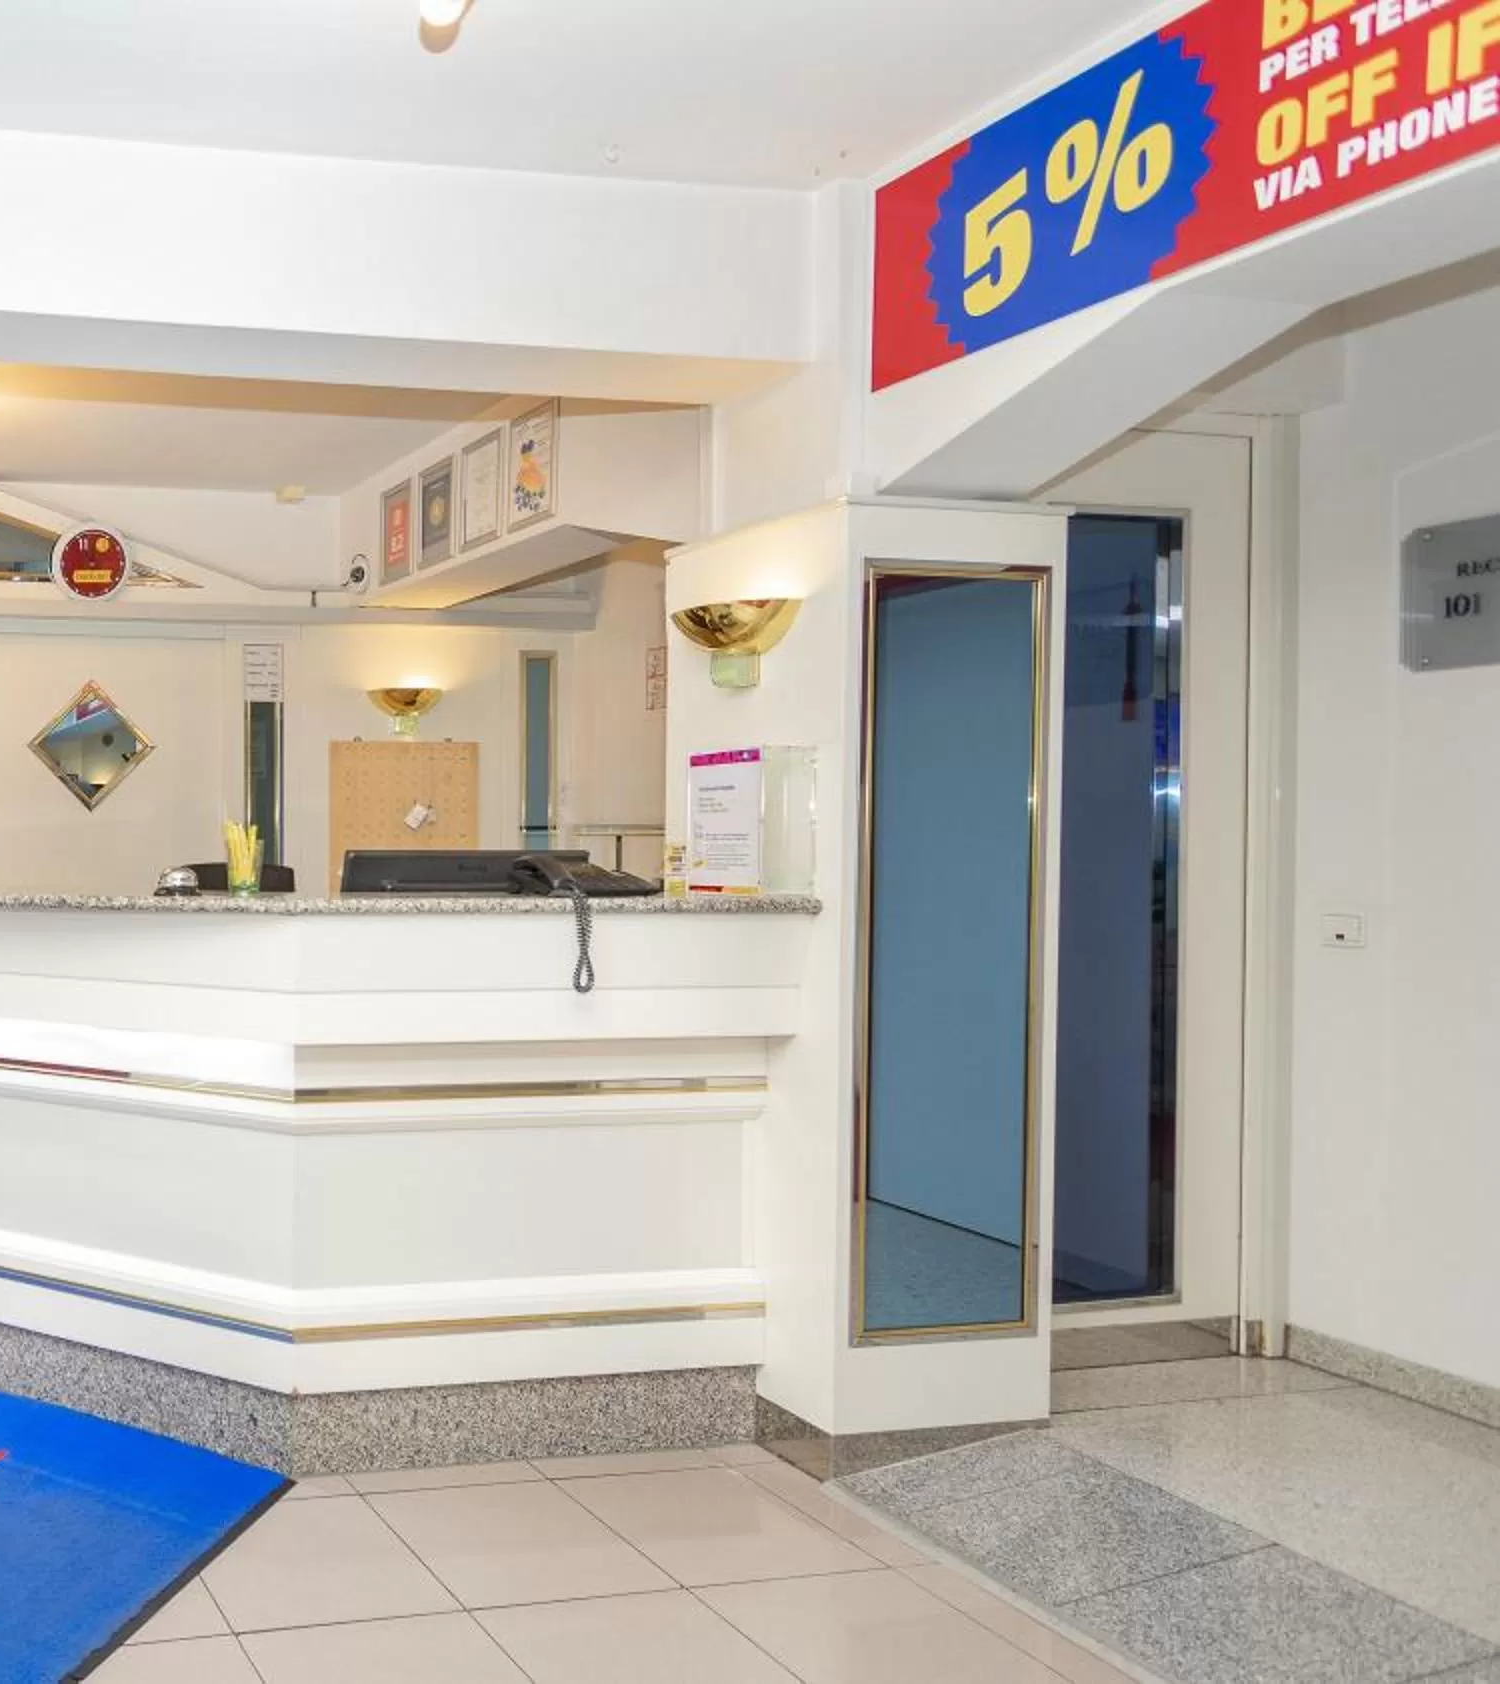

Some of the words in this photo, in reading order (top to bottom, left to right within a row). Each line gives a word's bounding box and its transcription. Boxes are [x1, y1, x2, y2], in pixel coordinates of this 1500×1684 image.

[1256, 48, 1399, 166] OFF
[1426, 0, 1500, 95] IF
[1259, 24, 1340, 93] PER
[1350, 0, 1453, 46] TEL
[1253, 155, 1322, 211] VIA
[1336, 75, 1499, 178] PHONE
[1444, 592, 1482, 619] 101
